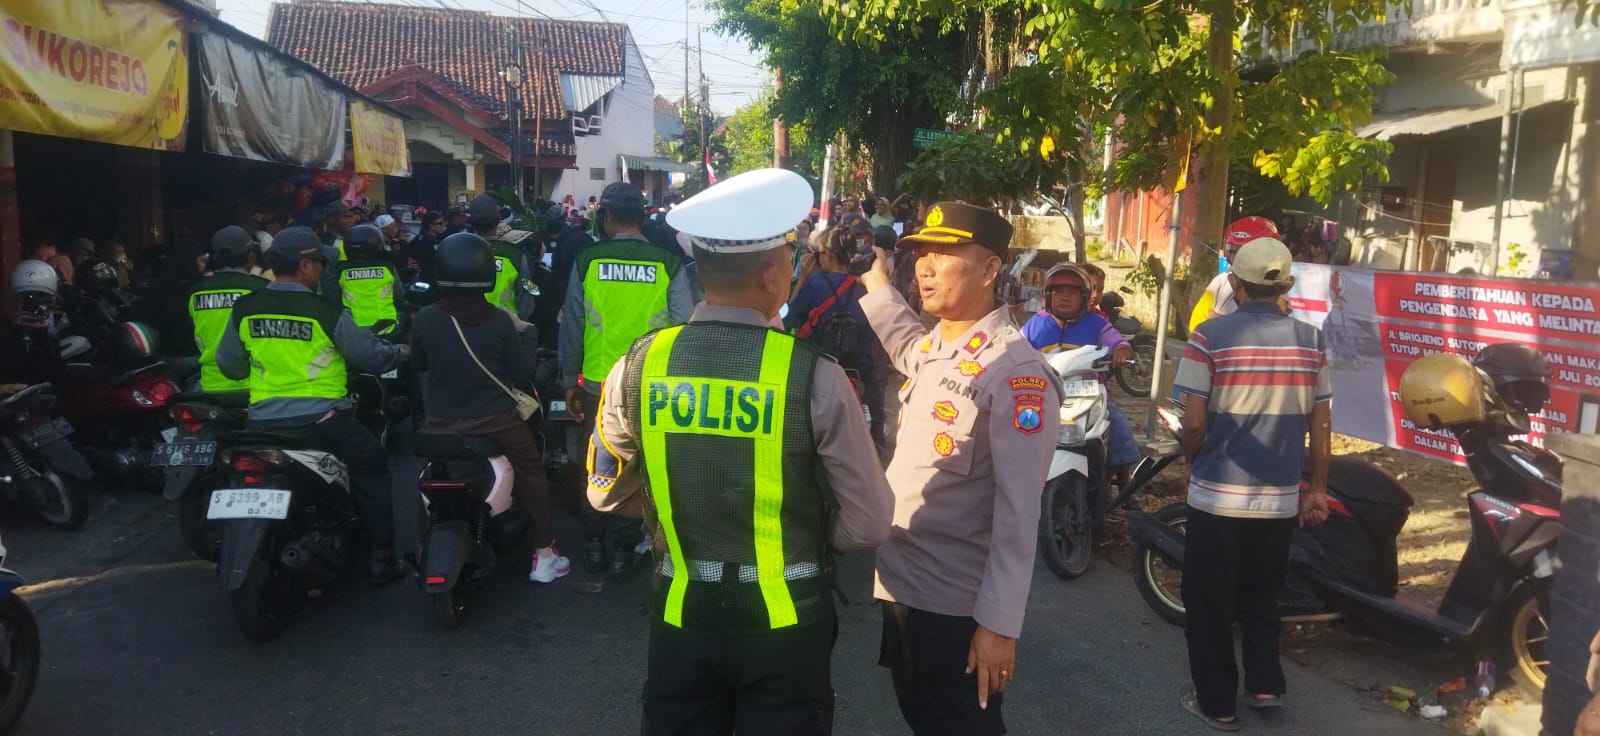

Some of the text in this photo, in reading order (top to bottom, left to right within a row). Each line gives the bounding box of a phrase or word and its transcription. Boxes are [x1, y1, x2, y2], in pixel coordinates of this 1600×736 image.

[5, 18, 148, 97] SUKOREJO
[346, 269, 383, 280] LINMAS
[599, 263, 656, 283] LINMAS
[1415, 282, 1595, 312] PEMBERITAHUAN KEPADA
[1400, 300, 1488, 321] PENGENDARA
[1493, 308, 1534, 327] YANG
[250, 319, 312, 340] LINMAS
[1399, 331, 1444, 346] BRIGJEND
[1390, 343, 1419, 356] TUTUP
[1559, 369, 1580, 383] JULI
[939, 377, 977, 400] POLRI
[649, 381, 775, 435] POLISI
[1415, 434, 1448, 452] DALAM
[214, 492, 222, 504] S
[1485, 494, 1520, 514] HONDA
